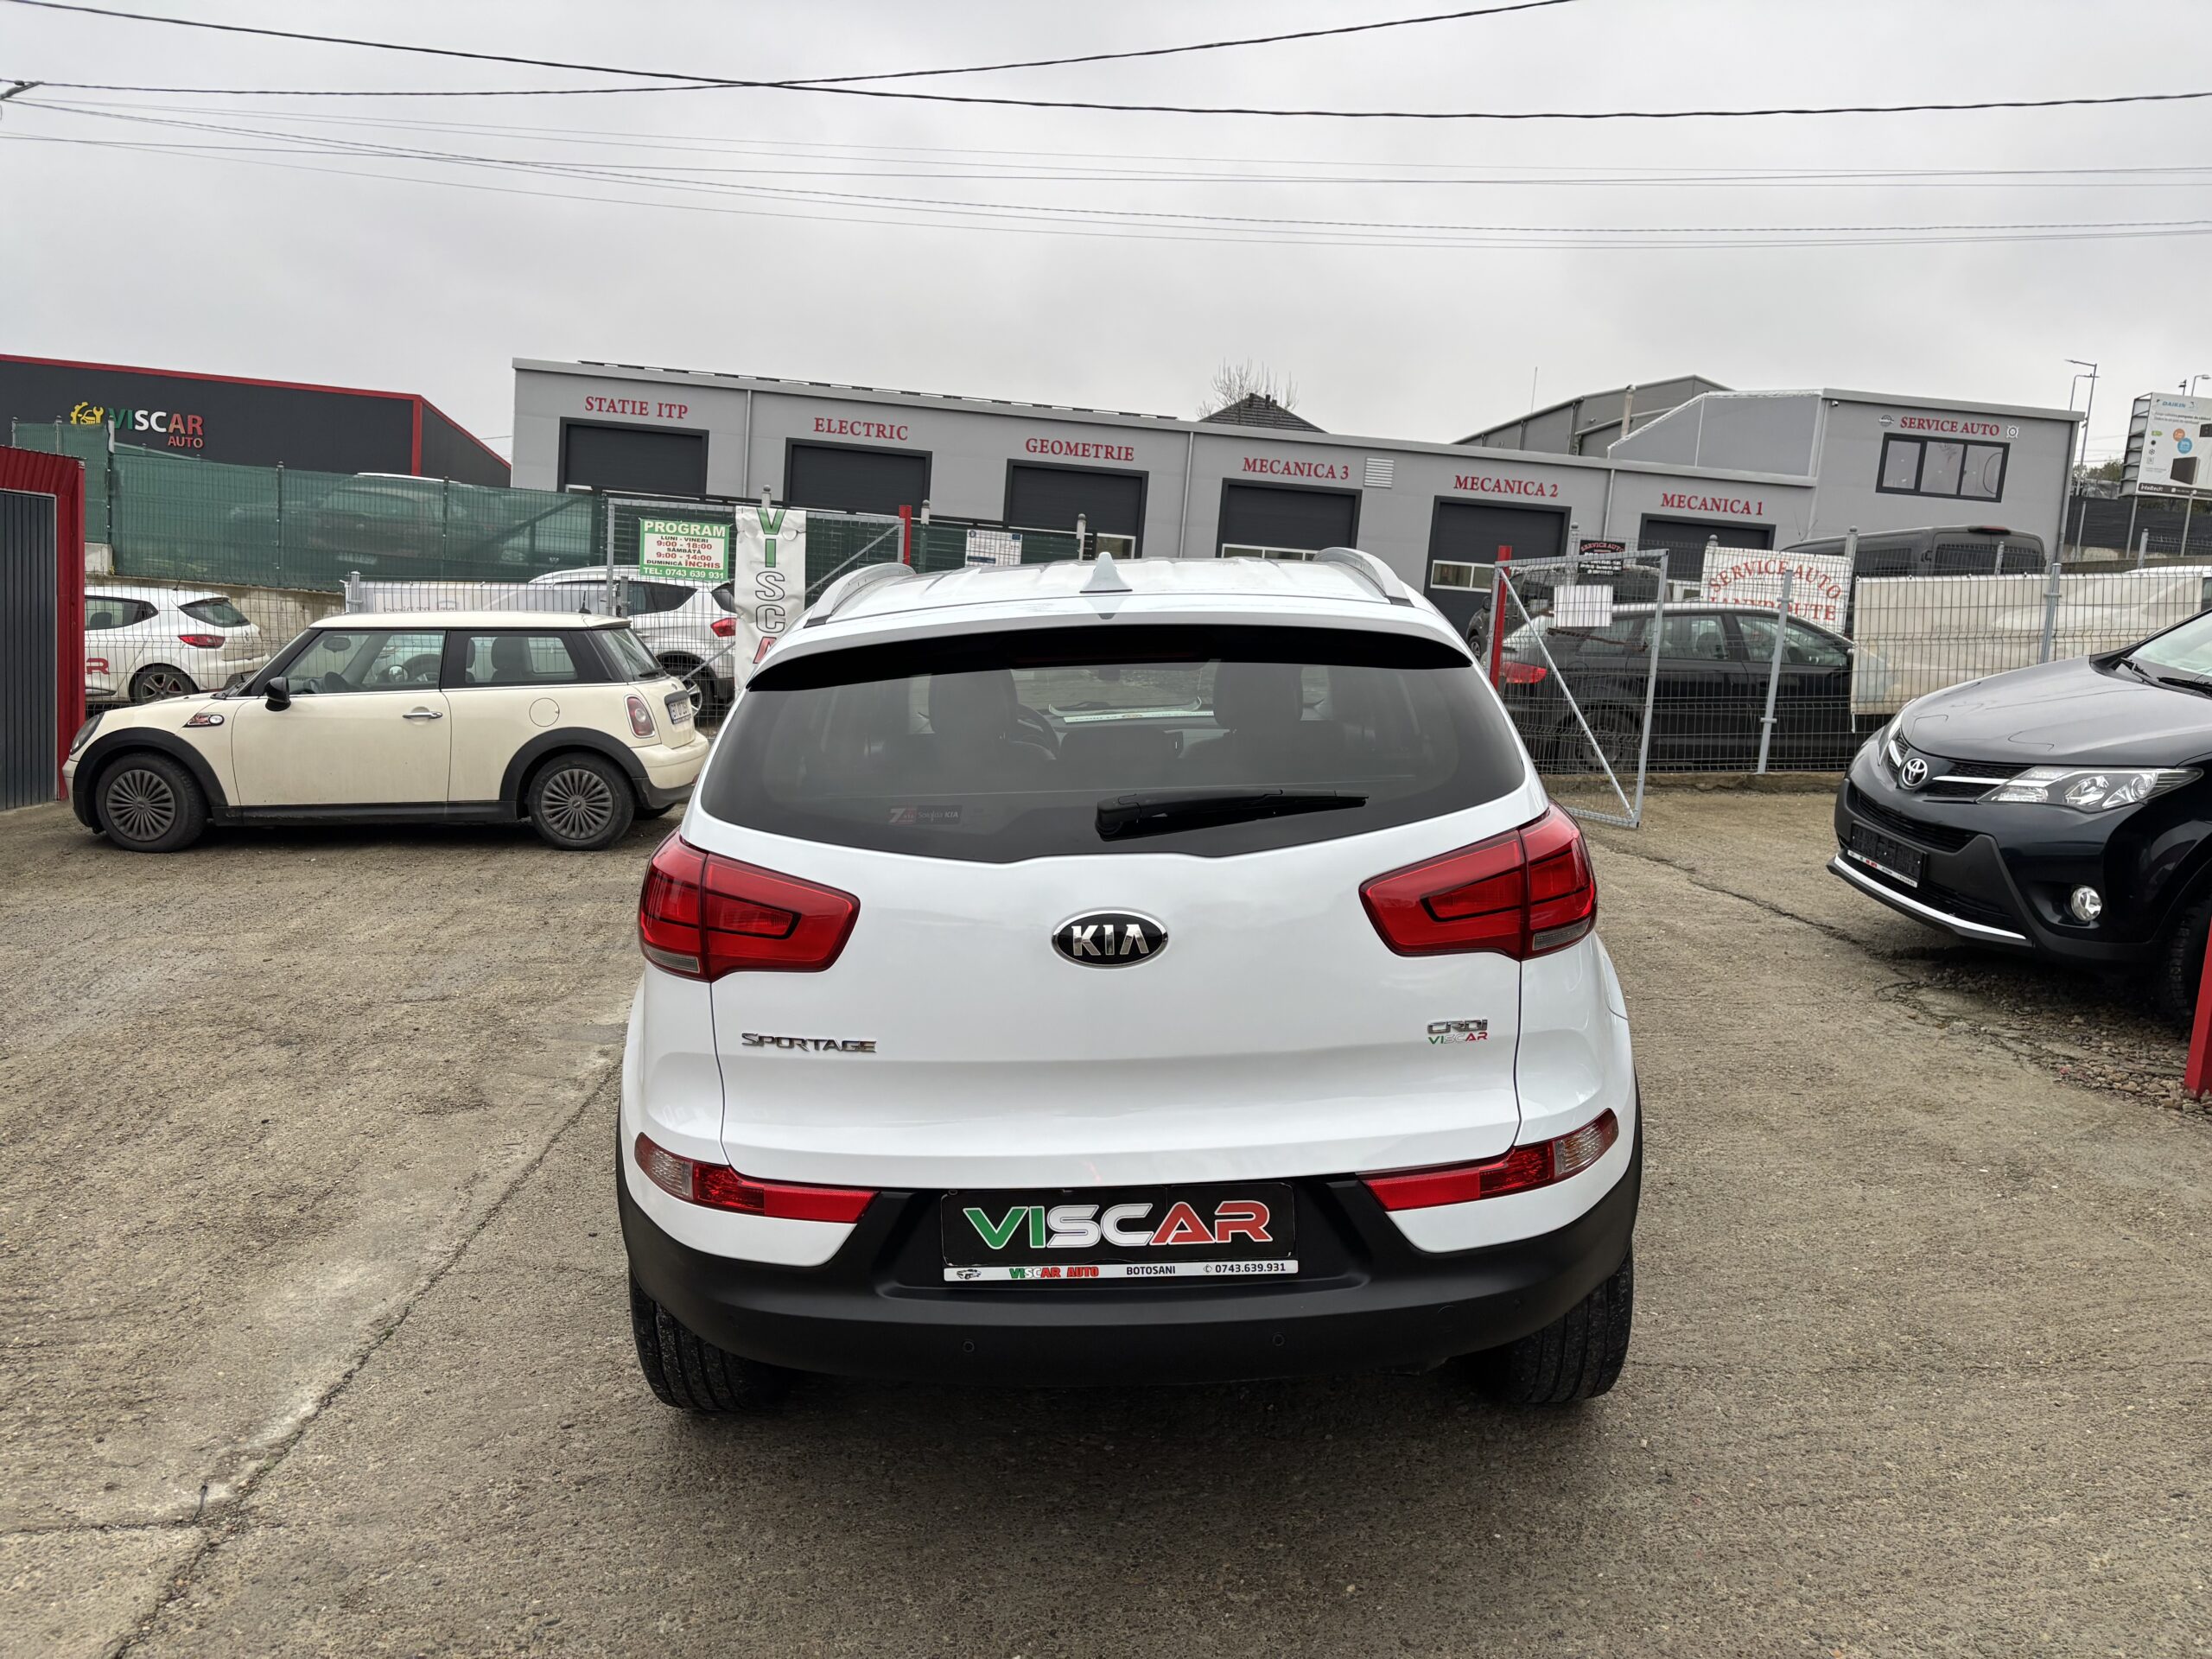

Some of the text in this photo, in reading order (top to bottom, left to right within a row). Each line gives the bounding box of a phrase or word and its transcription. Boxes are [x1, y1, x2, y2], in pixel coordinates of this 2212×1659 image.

[585, 396, 688, 419] STATIE ITP
[109, 408, 203, 435] VISCAR
[813, 417, 908, 441] ELECTRIC
[1900, 416, 1999, 436] SERVICE AUTO
[168, 435, 203, 448] AUTO
[1026, 438, 1135, 461] GEOMETRIE
[1243, 457, 1349, 480] MECANICA 3
[1453, 474, 1559, 498] MECANICA 2
[1661, 493, 1764, 516] MECANICA 1
[644, 521, 726, 537] PROGRAM
[690, 569, 706, 578] 639
[1708, 560, 1841, 599] SERVICE AUTO
[1071, 924, 1149, 957] KIA
[741, 1033, 877, 1053] SPORTAGE
[1428, 1032, 1488, 1045] VISCAR
[963, 1199, 1273, 1250] VISCAR
[1009, 1262, 1286, 1279] VISCAR AUTO BOTOSANI 0743.639.931
